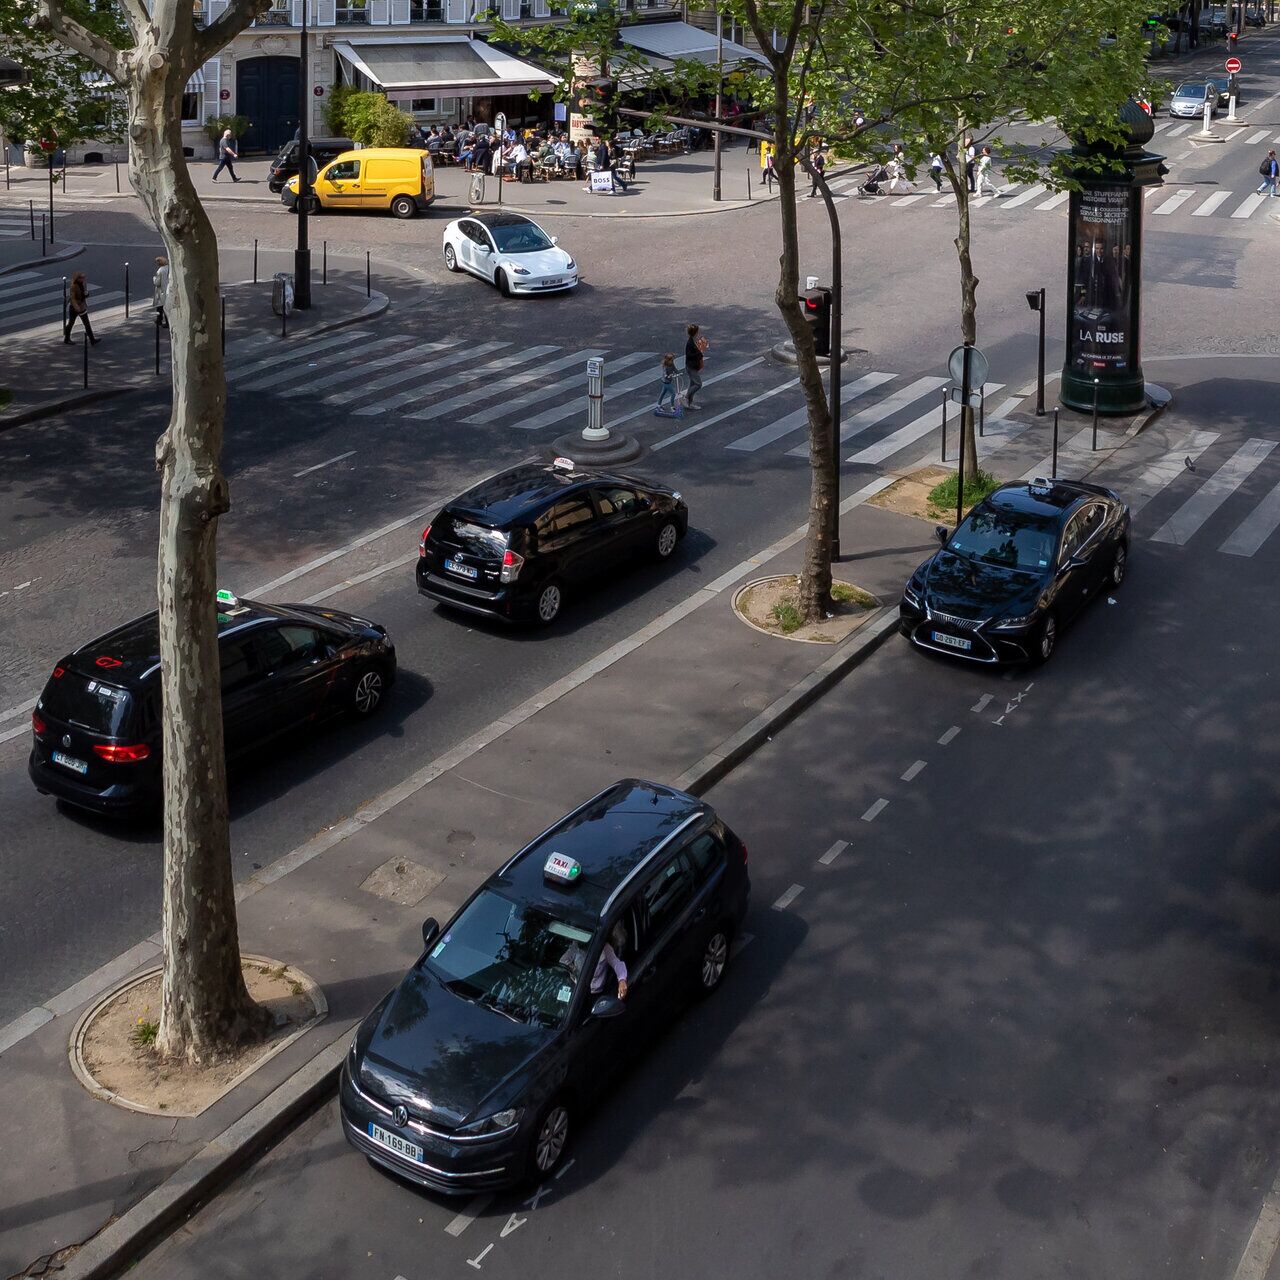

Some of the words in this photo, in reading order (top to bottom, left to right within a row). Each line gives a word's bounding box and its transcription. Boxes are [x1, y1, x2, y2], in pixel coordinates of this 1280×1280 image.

[1080, 329, 1093, 342] LA
[1095, 332, 1124, 343] RUSE
[991, 682, 1035, 726] TAXI
[553, 857, 569, 869] TAXI
[466, 1158, 576, 1269] TAXI
